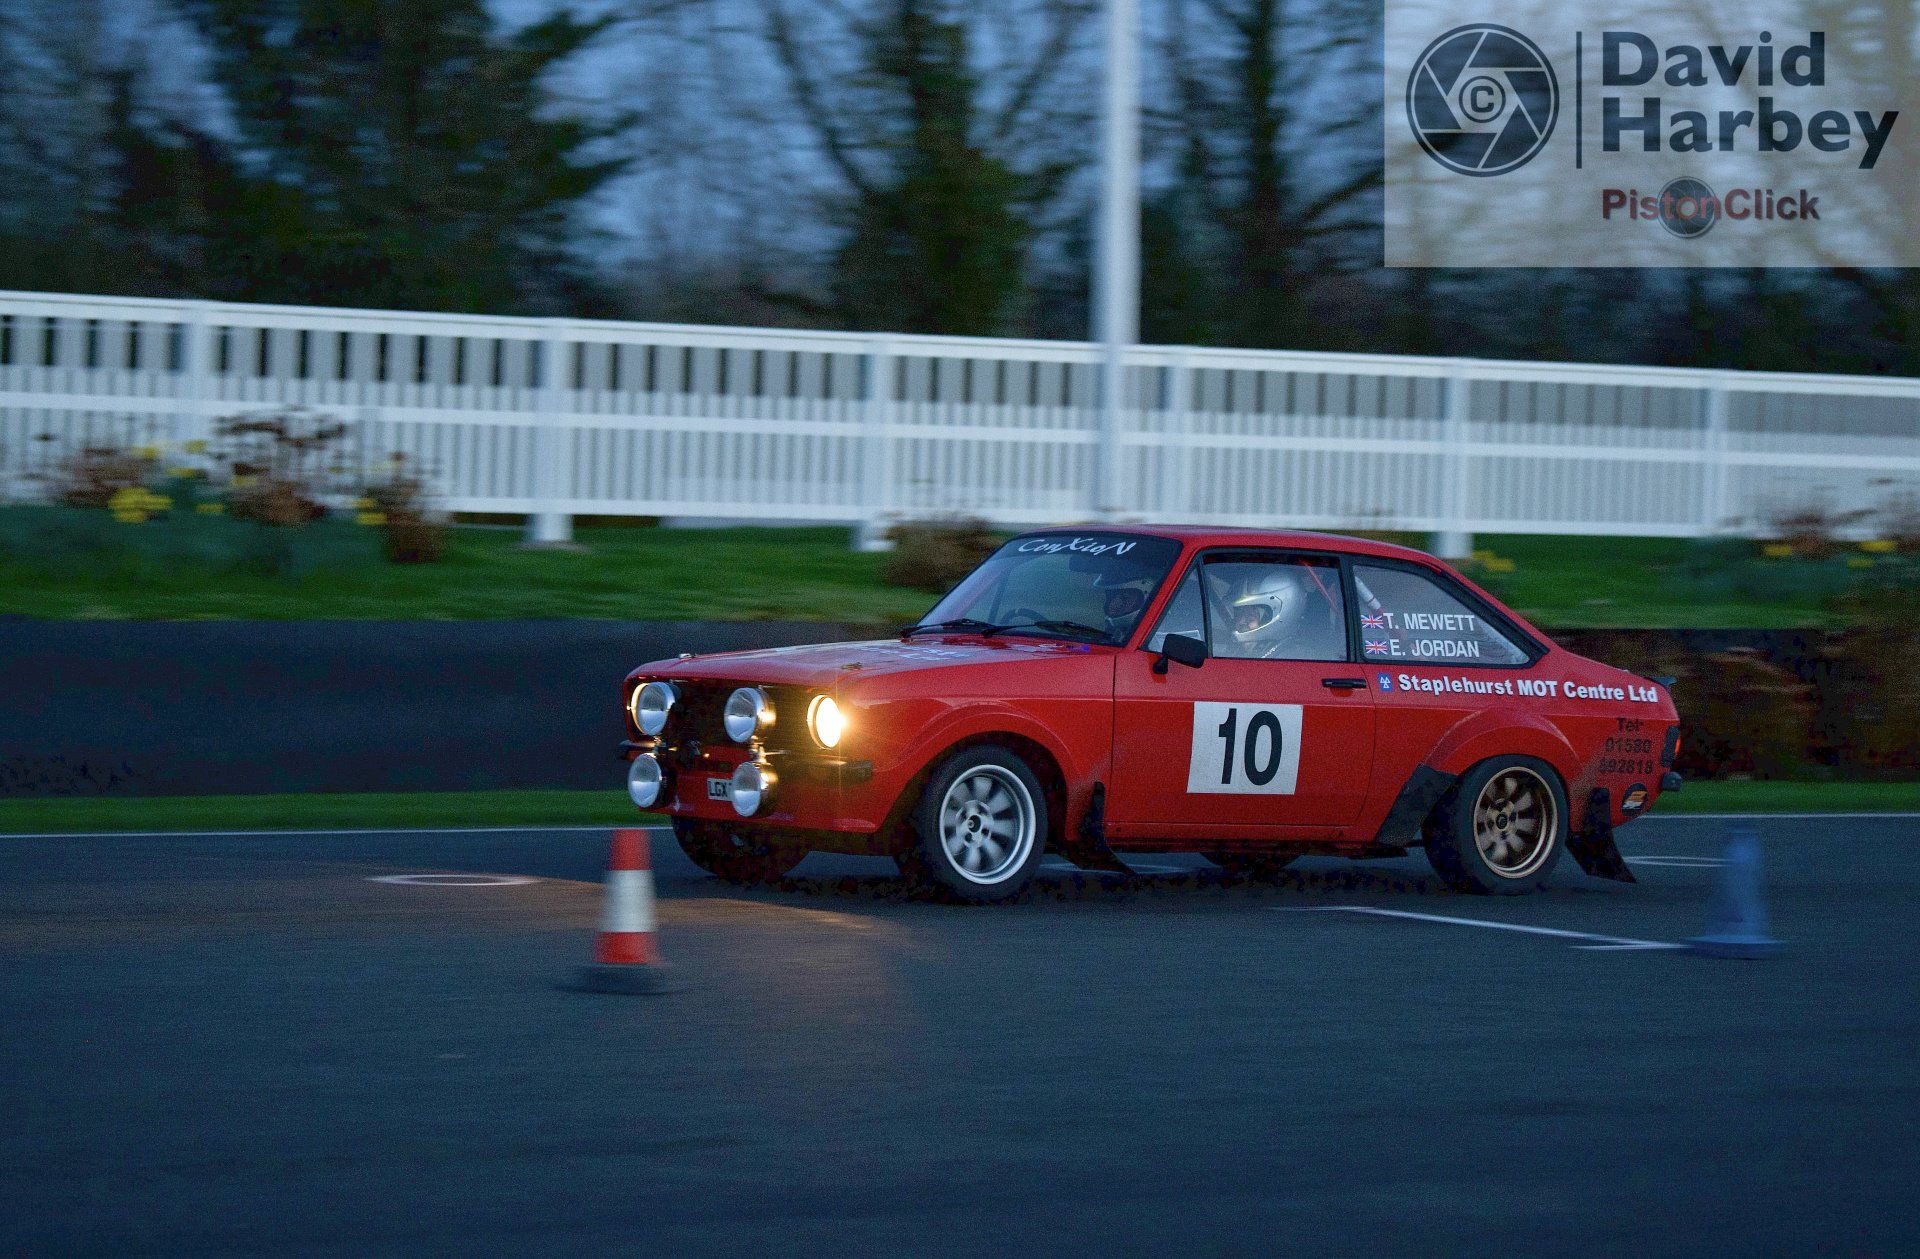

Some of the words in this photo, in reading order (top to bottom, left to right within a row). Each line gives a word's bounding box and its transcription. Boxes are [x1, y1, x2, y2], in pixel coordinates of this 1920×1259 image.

[1382, 612, 1400, 630] T.
[1403, 612, 1475, 632] MEWETT
[1389, 638, 1406, 656] E.
[1411, 639, 1480, 658] JORDAN
[1398, 673, 1514, 696] Staplehurst
[1517, 679, 1558, 698] MOT
[1563, 681, 1625, 700] Centre
[1627, 684, 1659, 703] Ltd
[1218, 708, 1283, 786] 10
